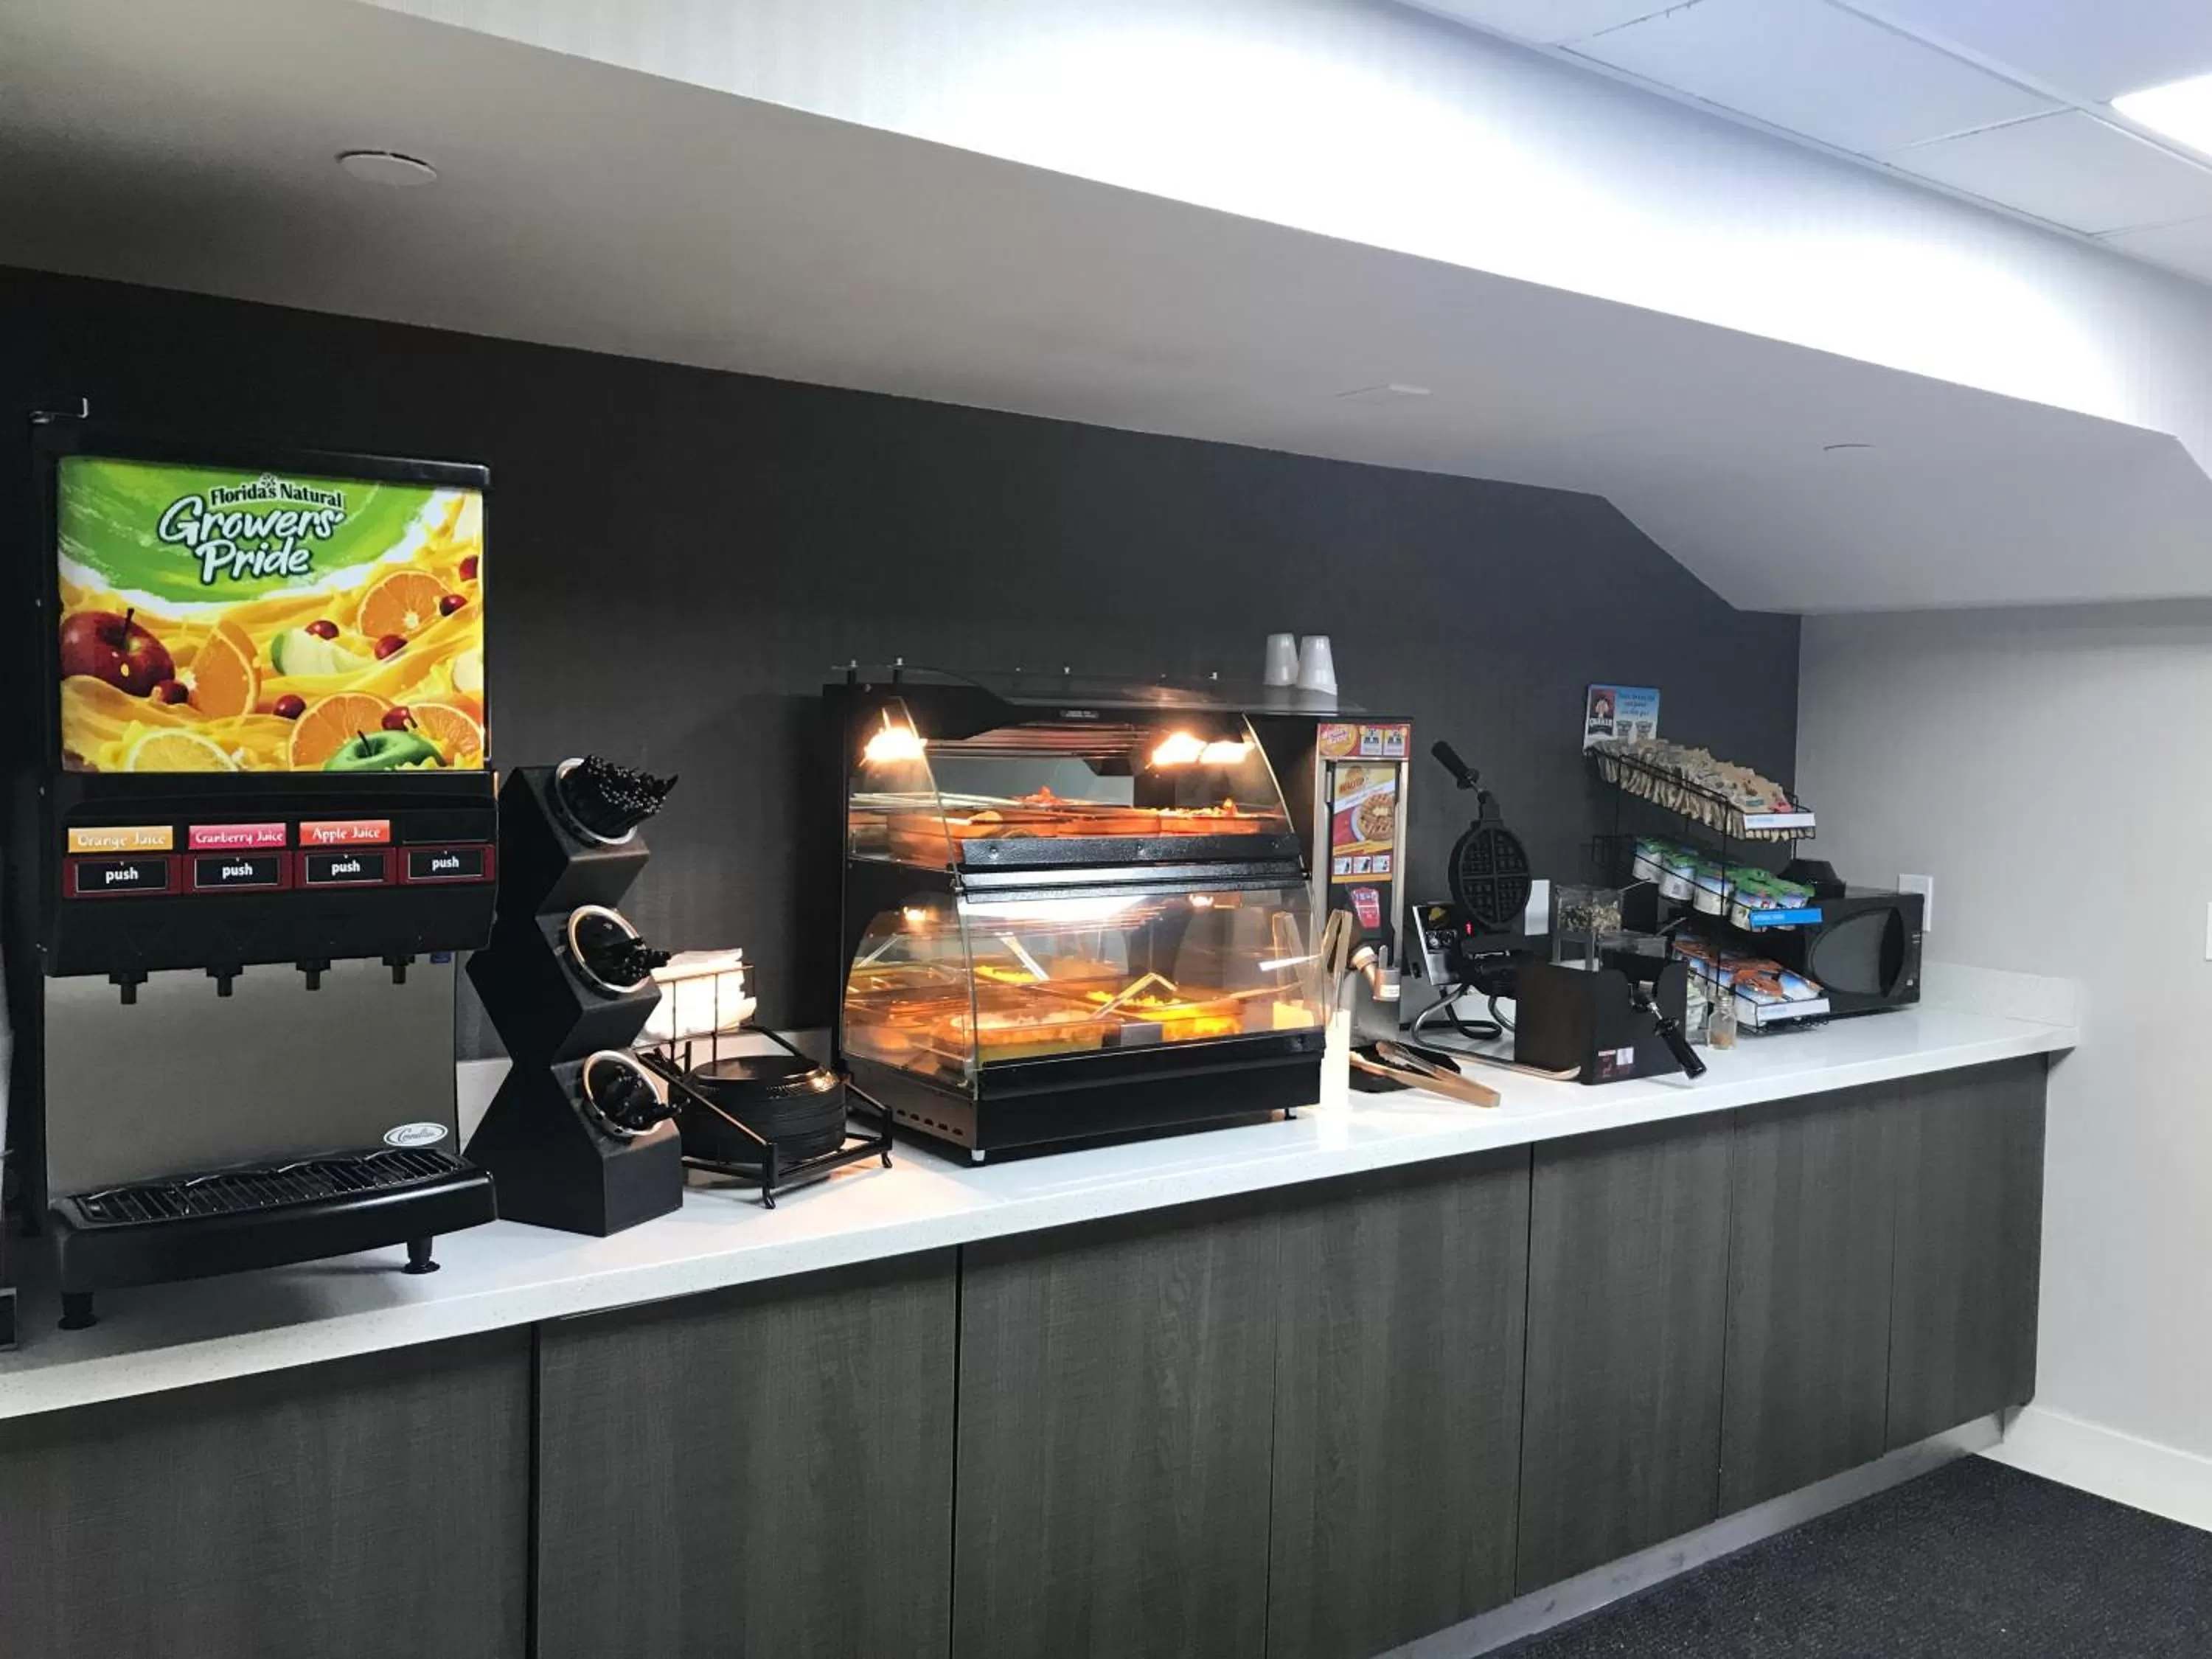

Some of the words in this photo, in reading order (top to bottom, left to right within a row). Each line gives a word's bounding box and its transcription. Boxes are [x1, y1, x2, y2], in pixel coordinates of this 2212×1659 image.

[280, 483, 342, 509] Natural
[193, 536, 311, 585] Pride
[77, 835, 127, 851] Orange
[134, 832, 167, 845] Juice
[195, 830, 253, 844] Cranberry
[257, 827, 284, 841] Juice
[312, 826, 347, 843] Apple
[351, 824, 381, 839] Juice
[221, 863, 254, 880] push
[331, 858, 361, 876] push
[431, 855, 460, 872] push
[105, 866, 139, 884] push
